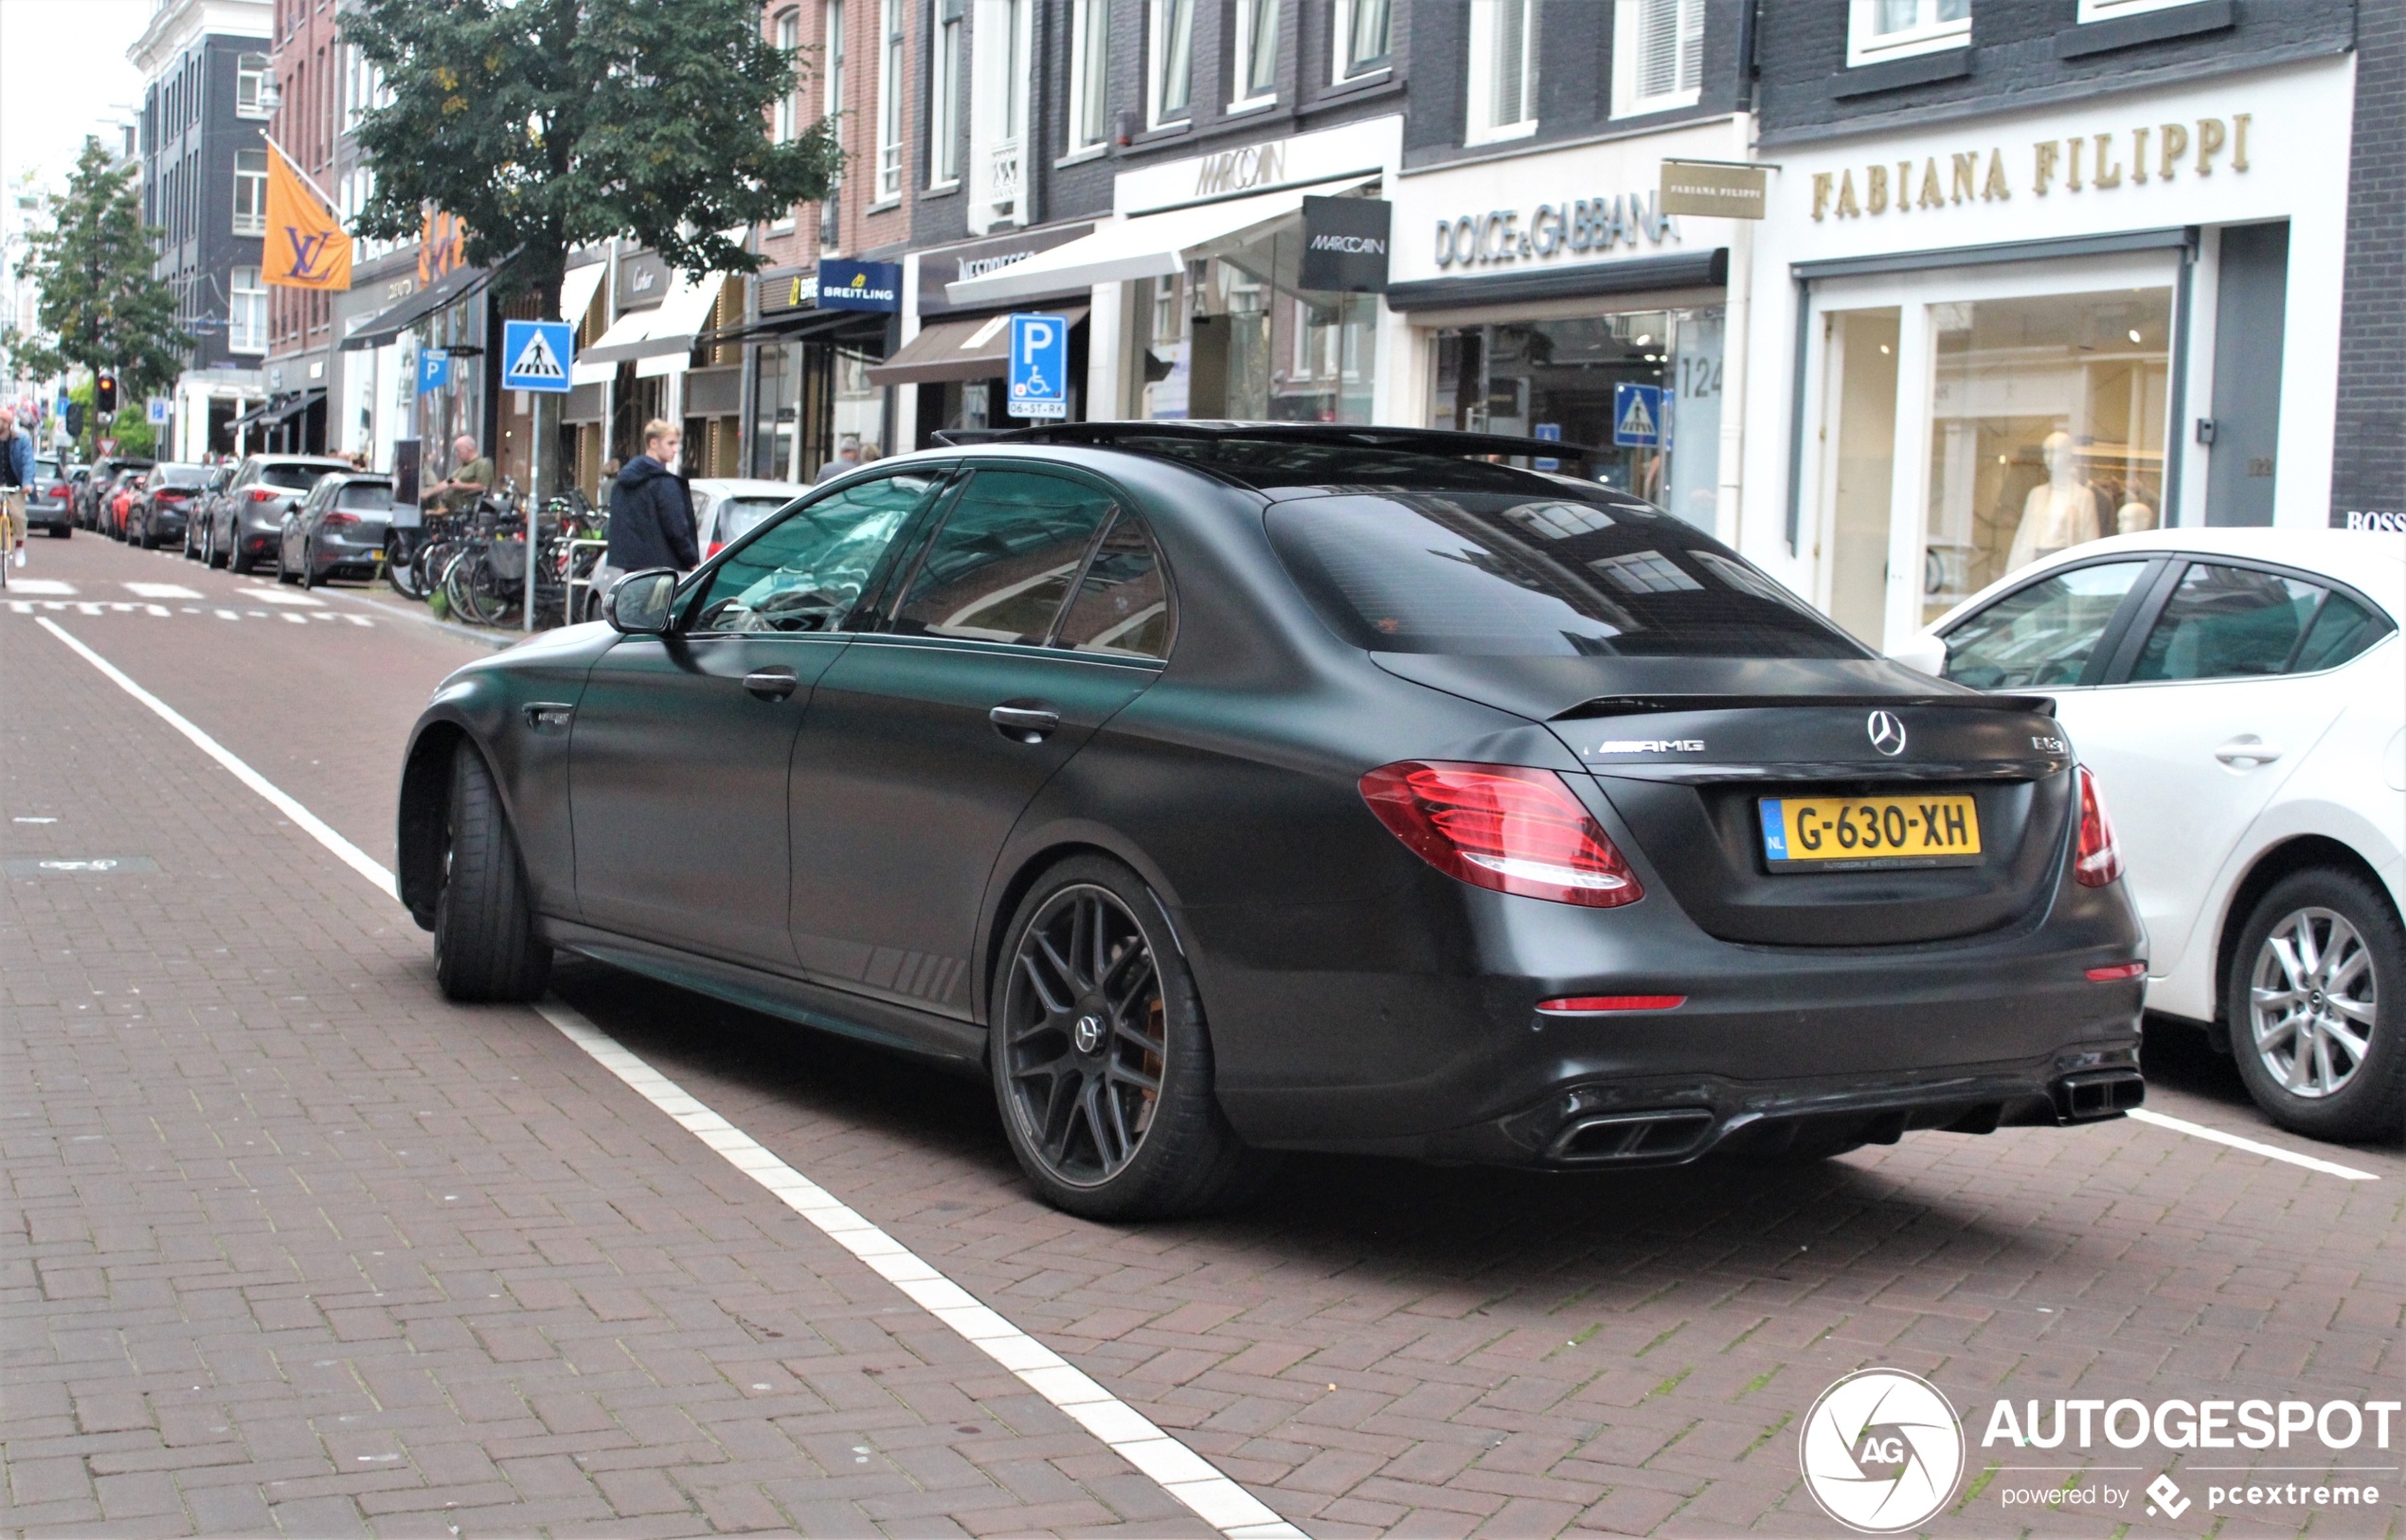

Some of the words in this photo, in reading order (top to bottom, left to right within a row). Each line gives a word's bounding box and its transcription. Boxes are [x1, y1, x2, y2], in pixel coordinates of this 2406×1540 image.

[1810, 147, 2011, 222] FABIANA
[2032, 112, 2252, 195] FILIPPI
[1670, 185, 1715, 195] FABIANA
[1719, 188, 1761, 198] FILIPPI
[824, 286, 894, 301] BREITLING
[1024, 322, 1053, 365] P
[427, 361, 440, 381] P
[1637, 740, 1705, 752] AMG
[1797, 804, 1968, 851] G-630-XH
[1768, 836, 1785, 851] NL
